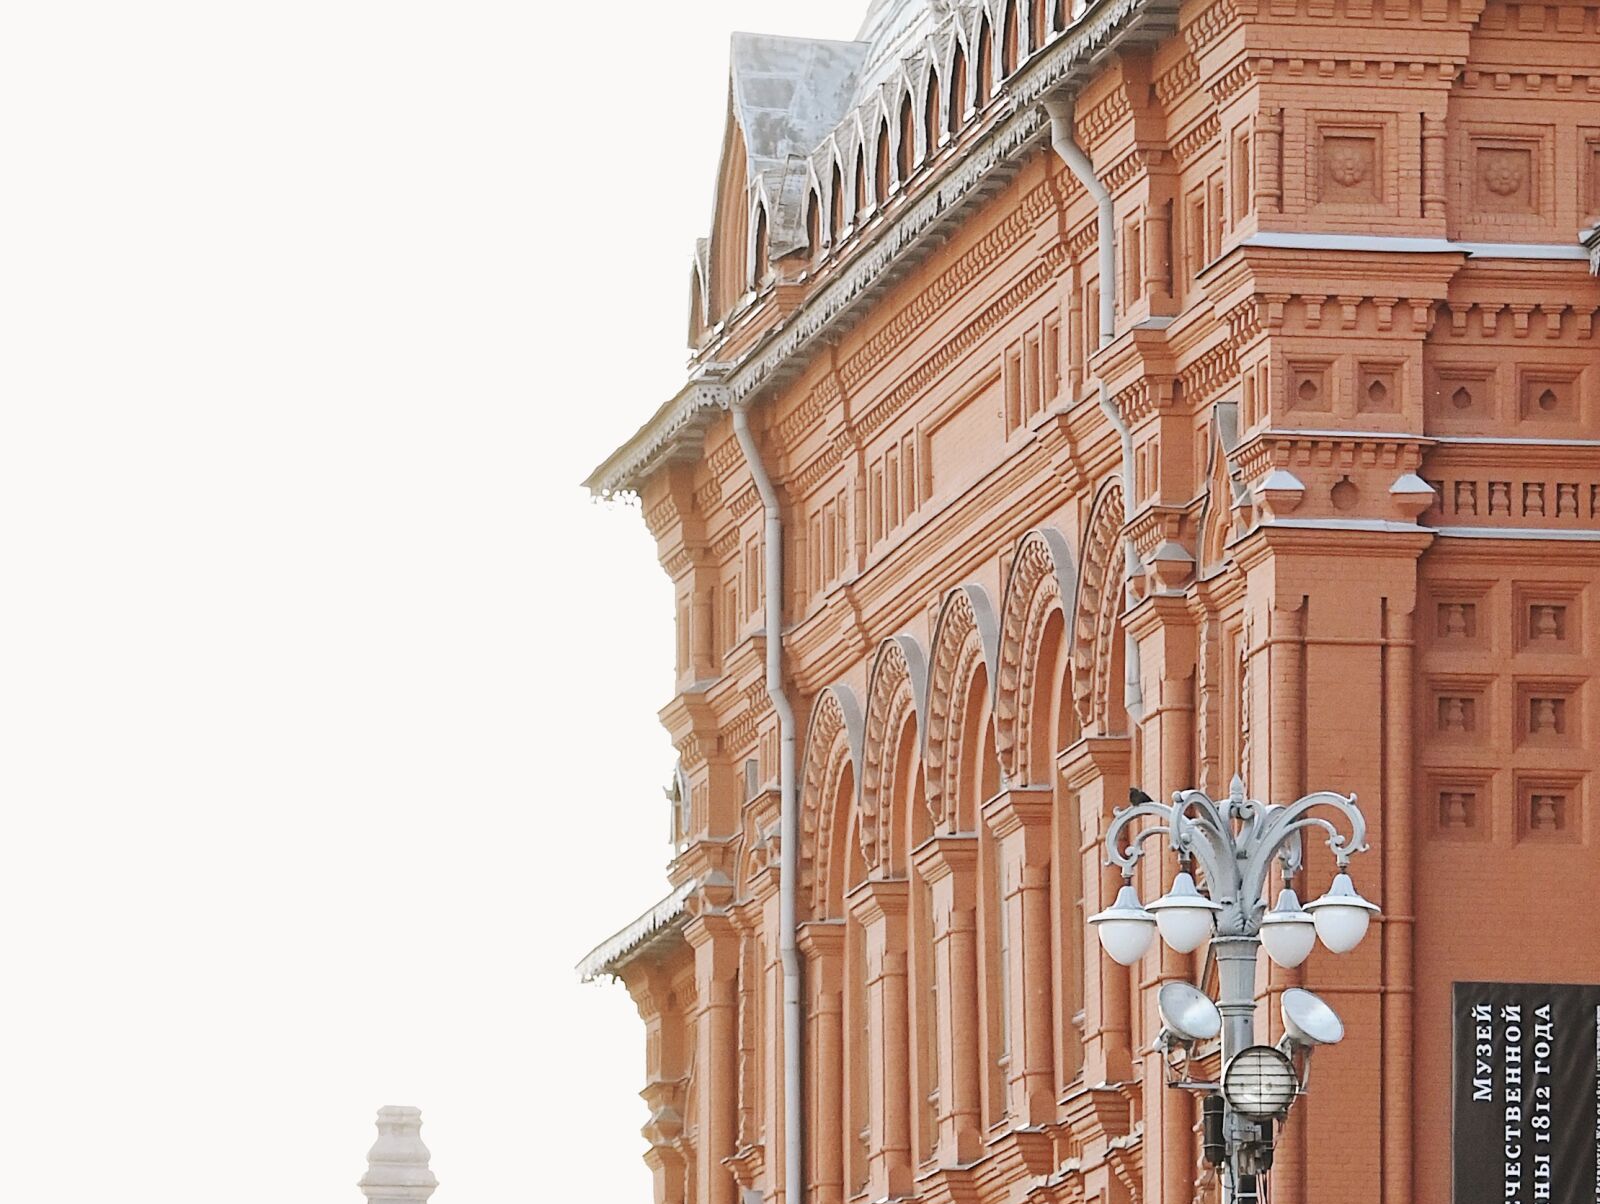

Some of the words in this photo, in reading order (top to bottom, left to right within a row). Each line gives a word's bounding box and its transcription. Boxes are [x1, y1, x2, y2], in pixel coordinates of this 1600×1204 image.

[1471, 1003, 1493, 1102] МУЗЕЙ
[1534, 1003, 1554, 1076] ГОДА
[1531, 1085, 1552, 1144] 1812
